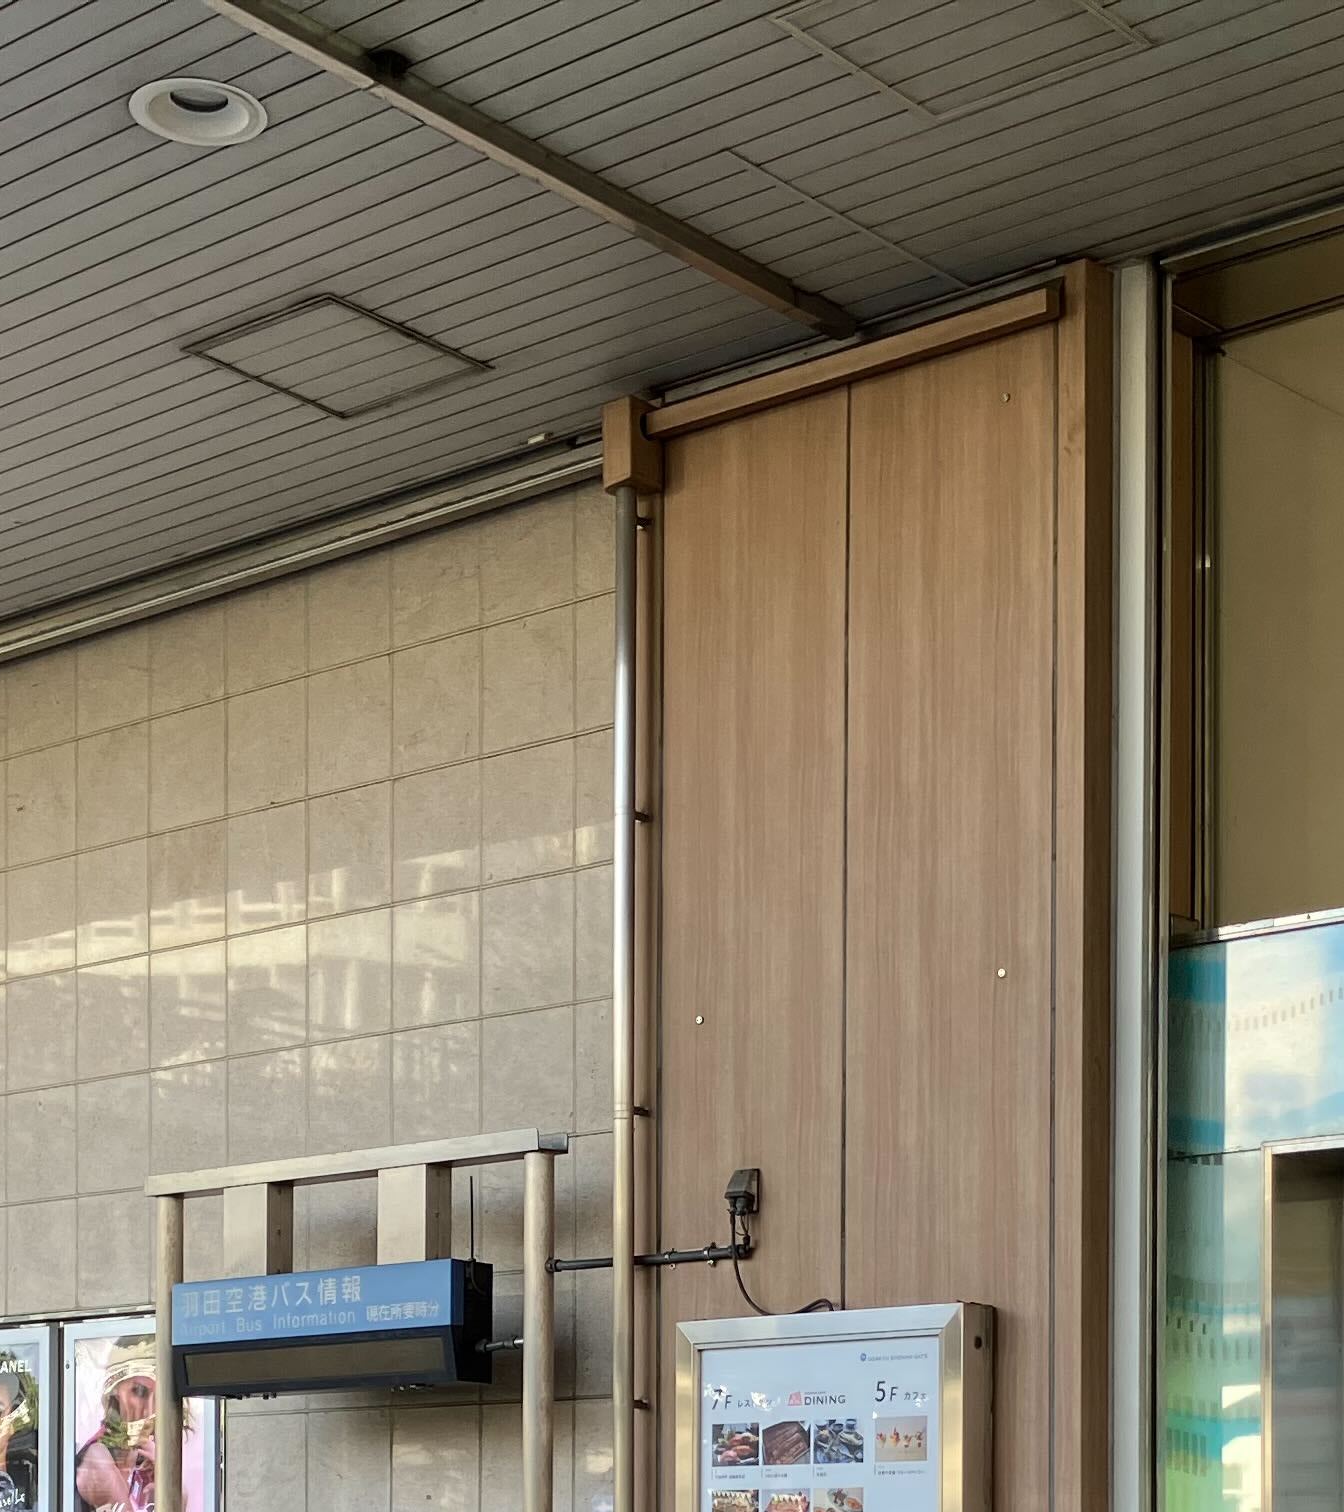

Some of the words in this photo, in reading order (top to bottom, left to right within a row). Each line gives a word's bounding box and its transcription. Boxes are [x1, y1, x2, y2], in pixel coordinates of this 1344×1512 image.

[181, 1274, 362, 1318] 羽田空港バス情報
[180, 1319, 225, 1338] Airport
[236, 1315, 262, 1332] Bus
[273, 1309, 356, 1330] Information
[804, 1393, 846, 1407] DINING
